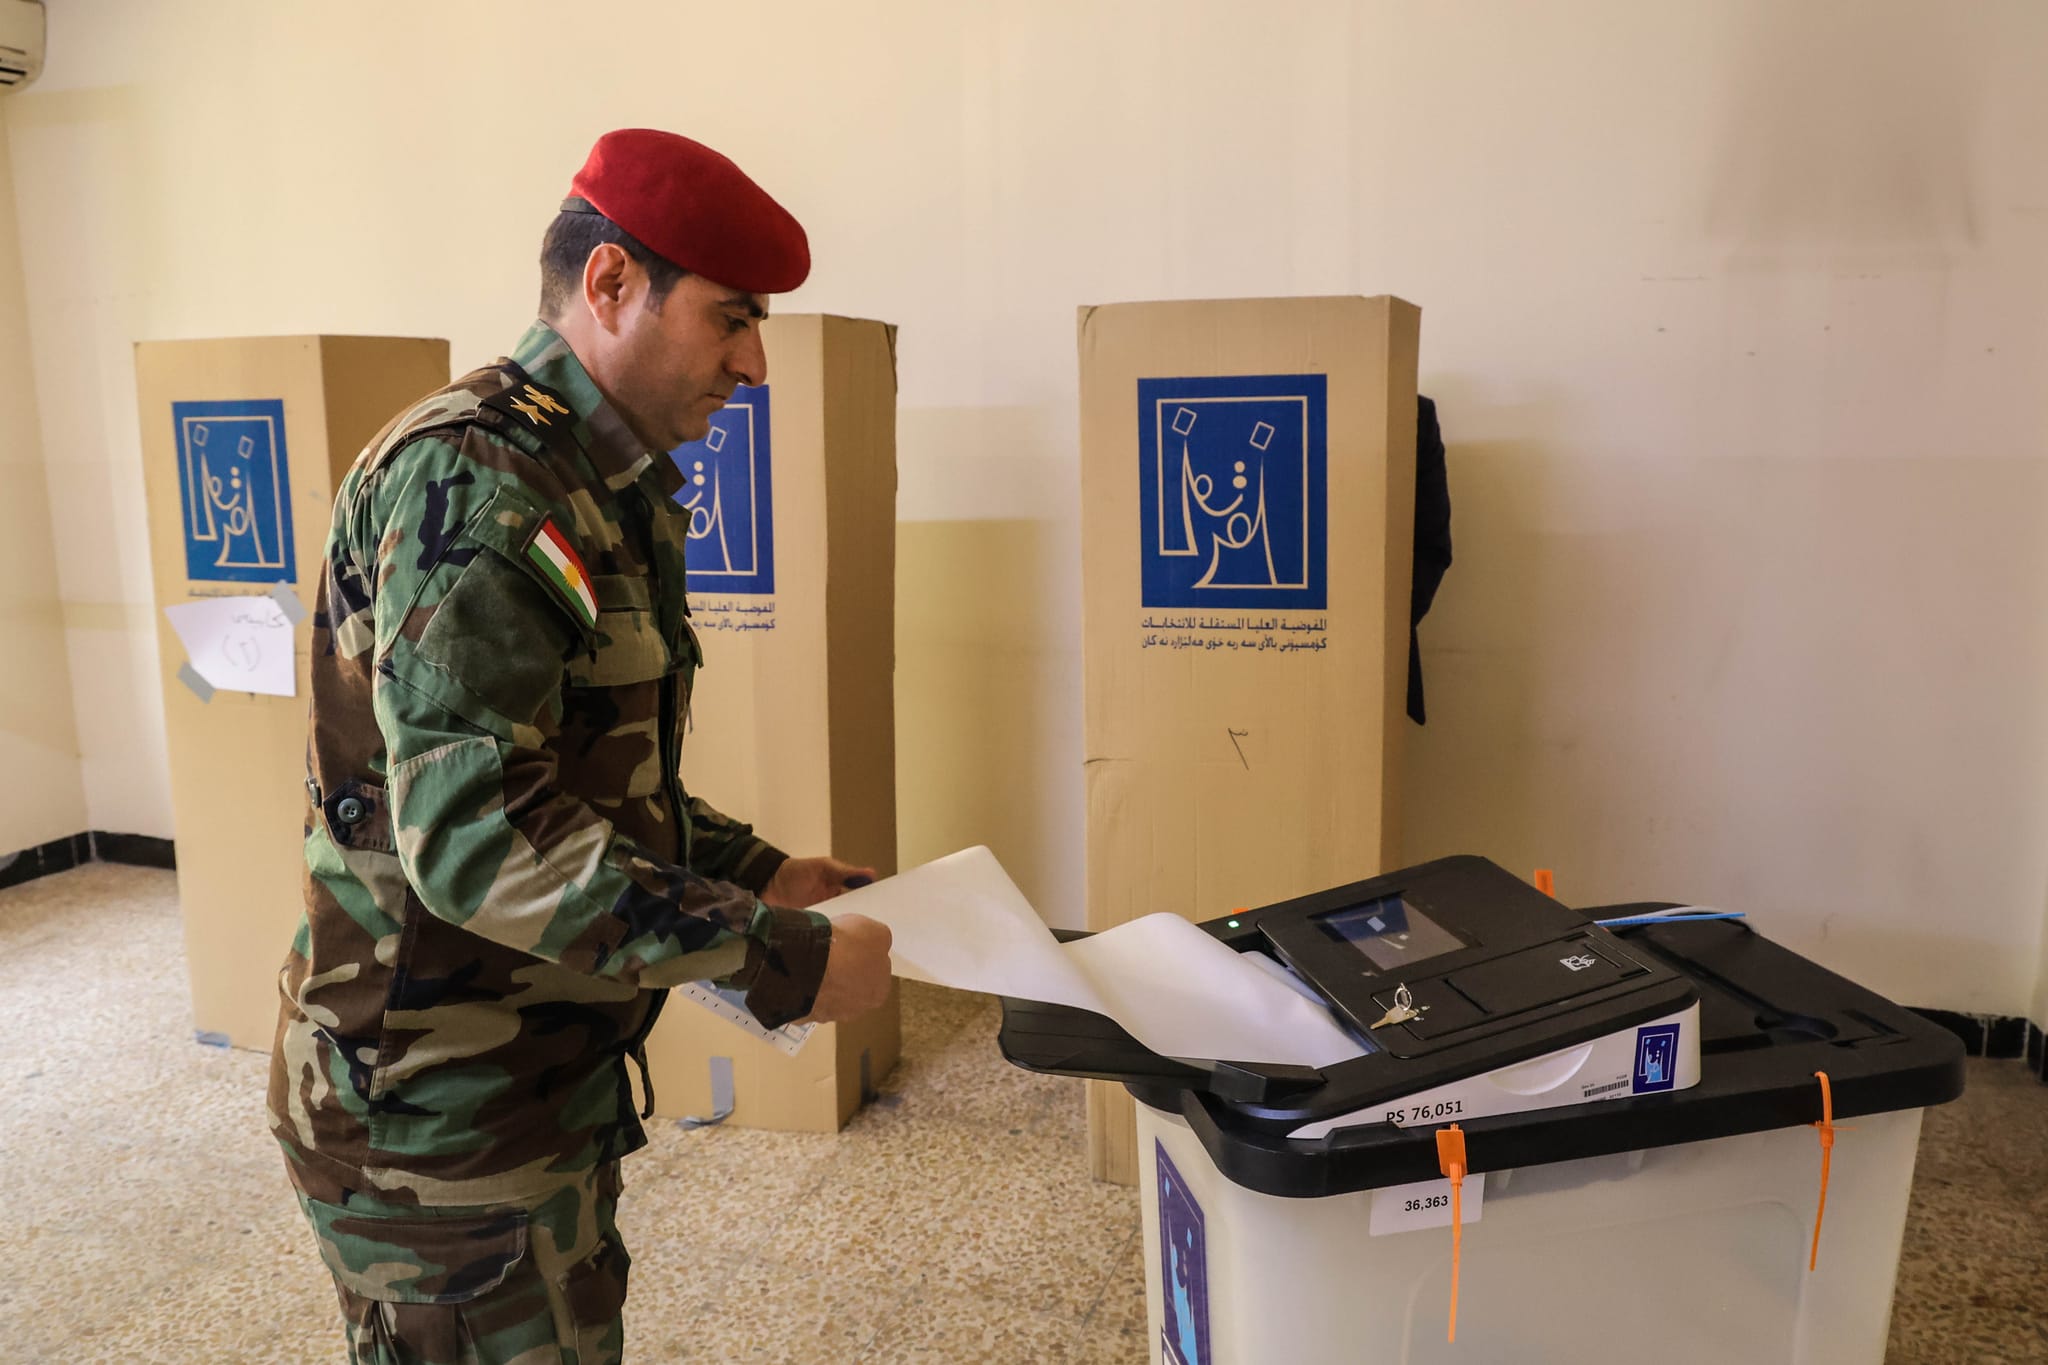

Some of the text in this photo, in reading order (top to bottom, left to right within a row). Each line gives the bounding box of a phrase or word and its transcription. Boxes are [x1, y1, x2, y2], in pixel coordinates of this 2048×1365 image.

[1141, 615, 1327, 634] المفوضية العليا المستقلة للانتخابات
[1386, 1100, 1463, 1123] PS 76,051
[1404, 1195, 1449, 1212] 36,363
